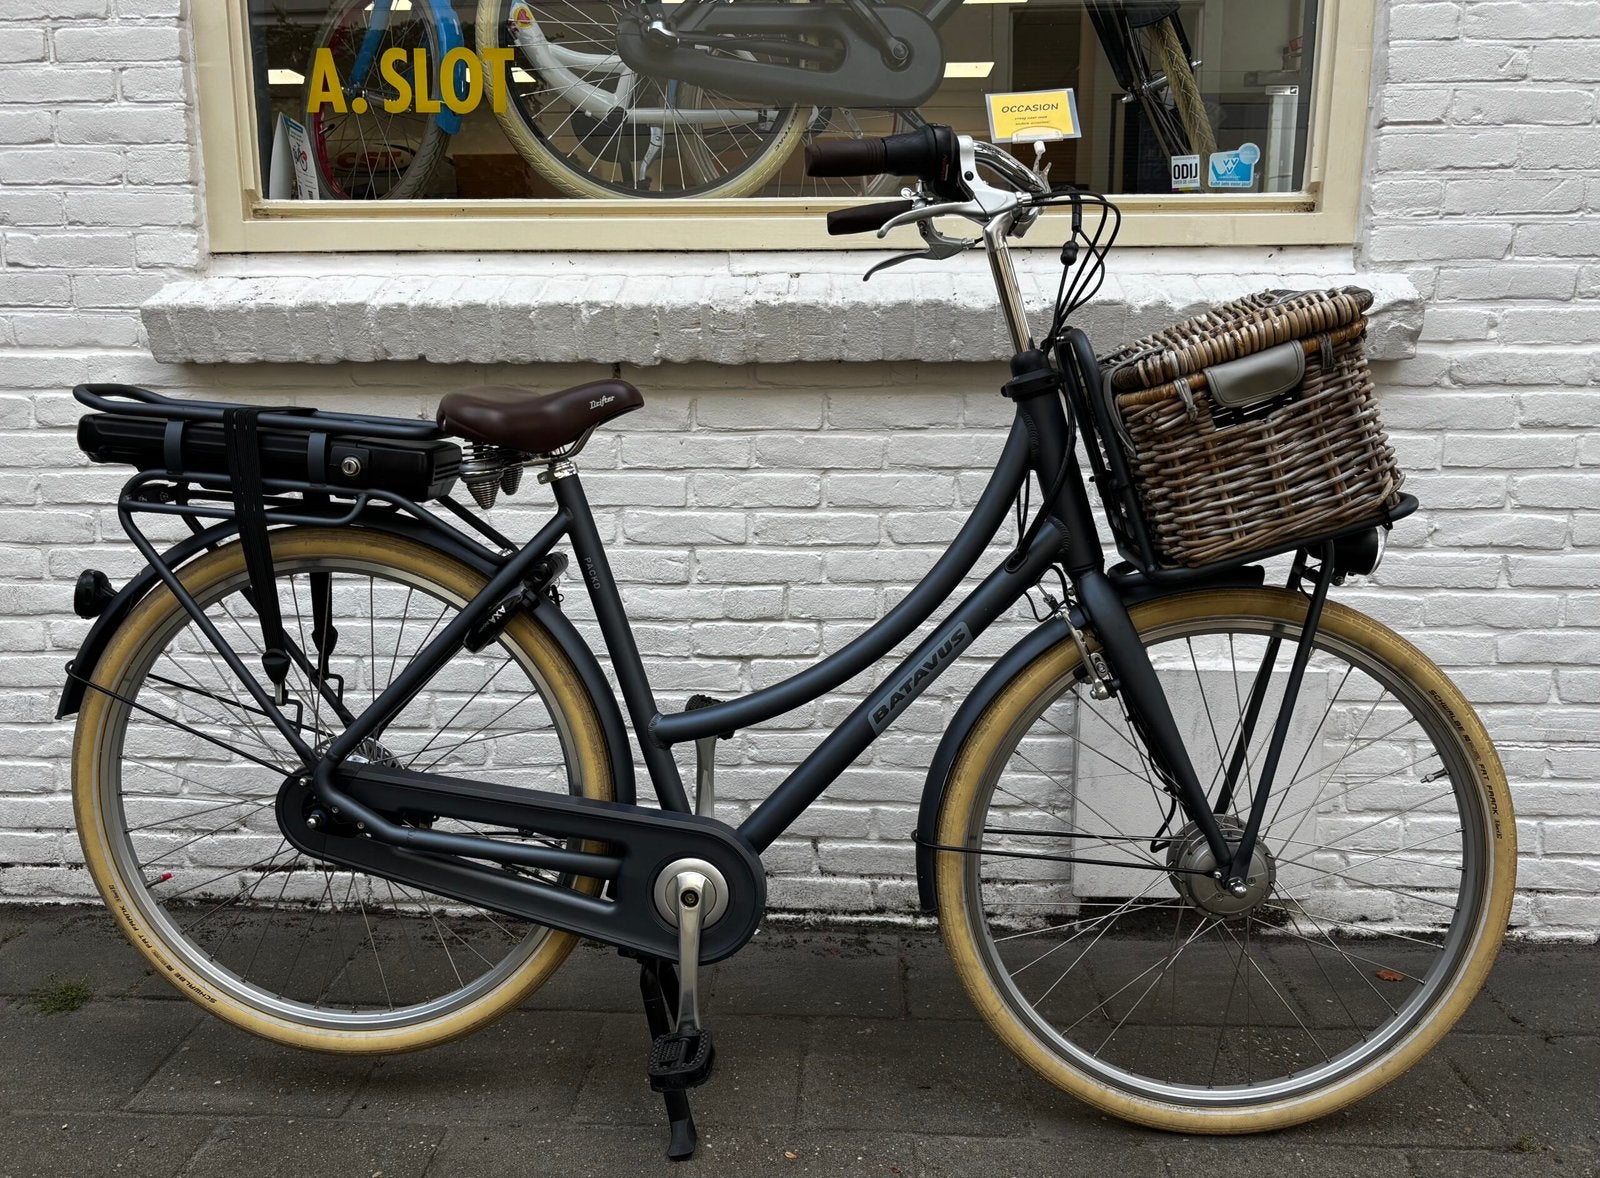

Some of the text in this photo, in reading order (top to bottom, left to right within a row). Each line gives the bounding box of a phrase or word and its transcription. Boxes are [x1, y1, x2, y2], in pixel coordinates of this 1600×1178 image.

[307, 47, 515, 114] A. SLOT
[1001, 103, 1059, 114] OCCASION
[1173, 163, 1198, 180] ODIJ
[589, 395, 615, 410] Drifter
[584, 556, 601, 590] PACKD
[488, 604, 506, 624] AXA
[872, 628, 966, 725] BATAVUS
[1428, 689, 1466, 732] SCHWALBE
[1478, 763, 1490, 781] FAT
[1486, 784, 1499, 815] FRANK
[173, 972, 218, 1004] SCHWALBE
